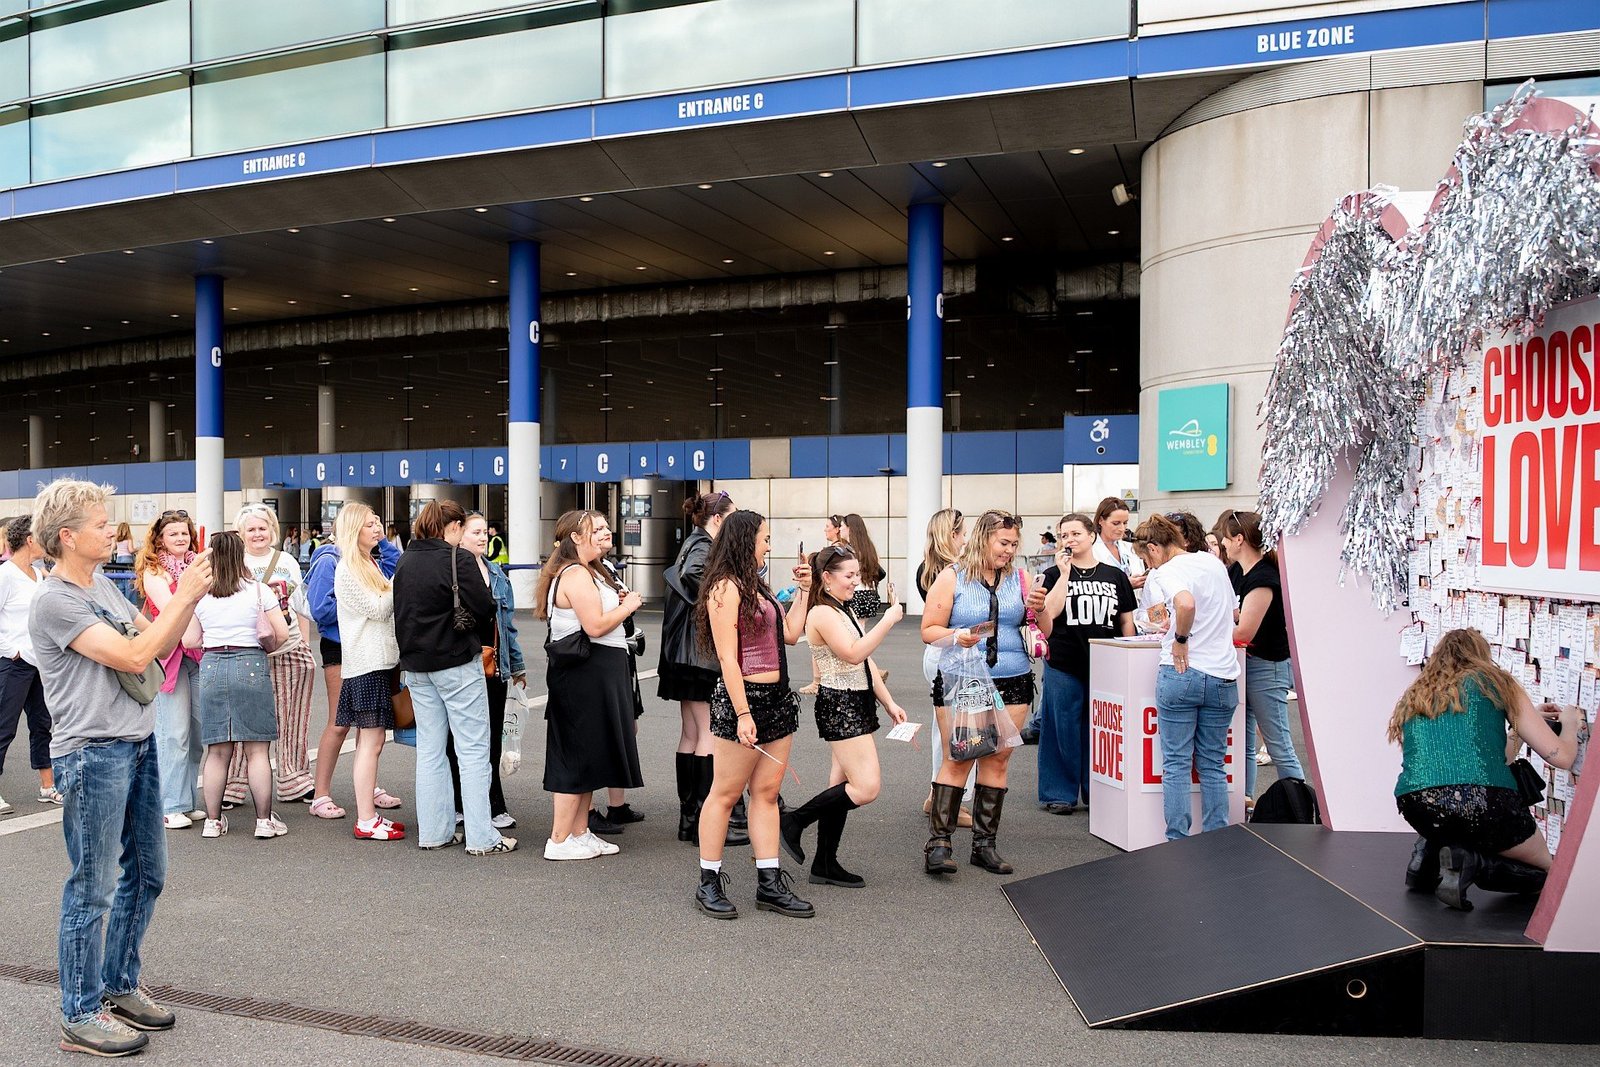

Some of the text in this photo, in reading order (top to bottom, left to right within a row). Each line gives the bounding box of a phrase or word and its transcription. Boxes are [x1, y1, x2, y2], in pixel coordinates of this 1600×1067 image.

[1257, 25, 1355, 53] BLUE ZONE
[678, 93, 763, 119] ENTRANCE C
[243, 152, 305, 174] ENTRANCE C
[936, 292, 944, 319] C
[529, 320, 540, 344] C
[211, 346, 222, 368] C
[1166, 438, 1206, 450] WEMBLEY
[348, 465, 354, 476] 2
[369, 464, 376, 475] 3
[399, 459, 409, 479] C
[434, 462, 441, 473] 4
[458, 461, 465, 473] 5
[493, 456, 504, 476] C
[560, 459, 567, 470] 7
[597, 453, 609, 474] C
[640, 456, 647, 468] 8
[667, 455, 675, 467] 9
[693, 450, 705, 472] C
[316, 462, 326, 481] C
[1481, 422, 1600, 572] LOVE
[1066, 580, 1118, 600] CHOOSE
[1065, 594, 1119, 627] LOVE
[1092, 698, 1123, 732] CHOOSE
[1092, 727, 1123, 782] LOVE
